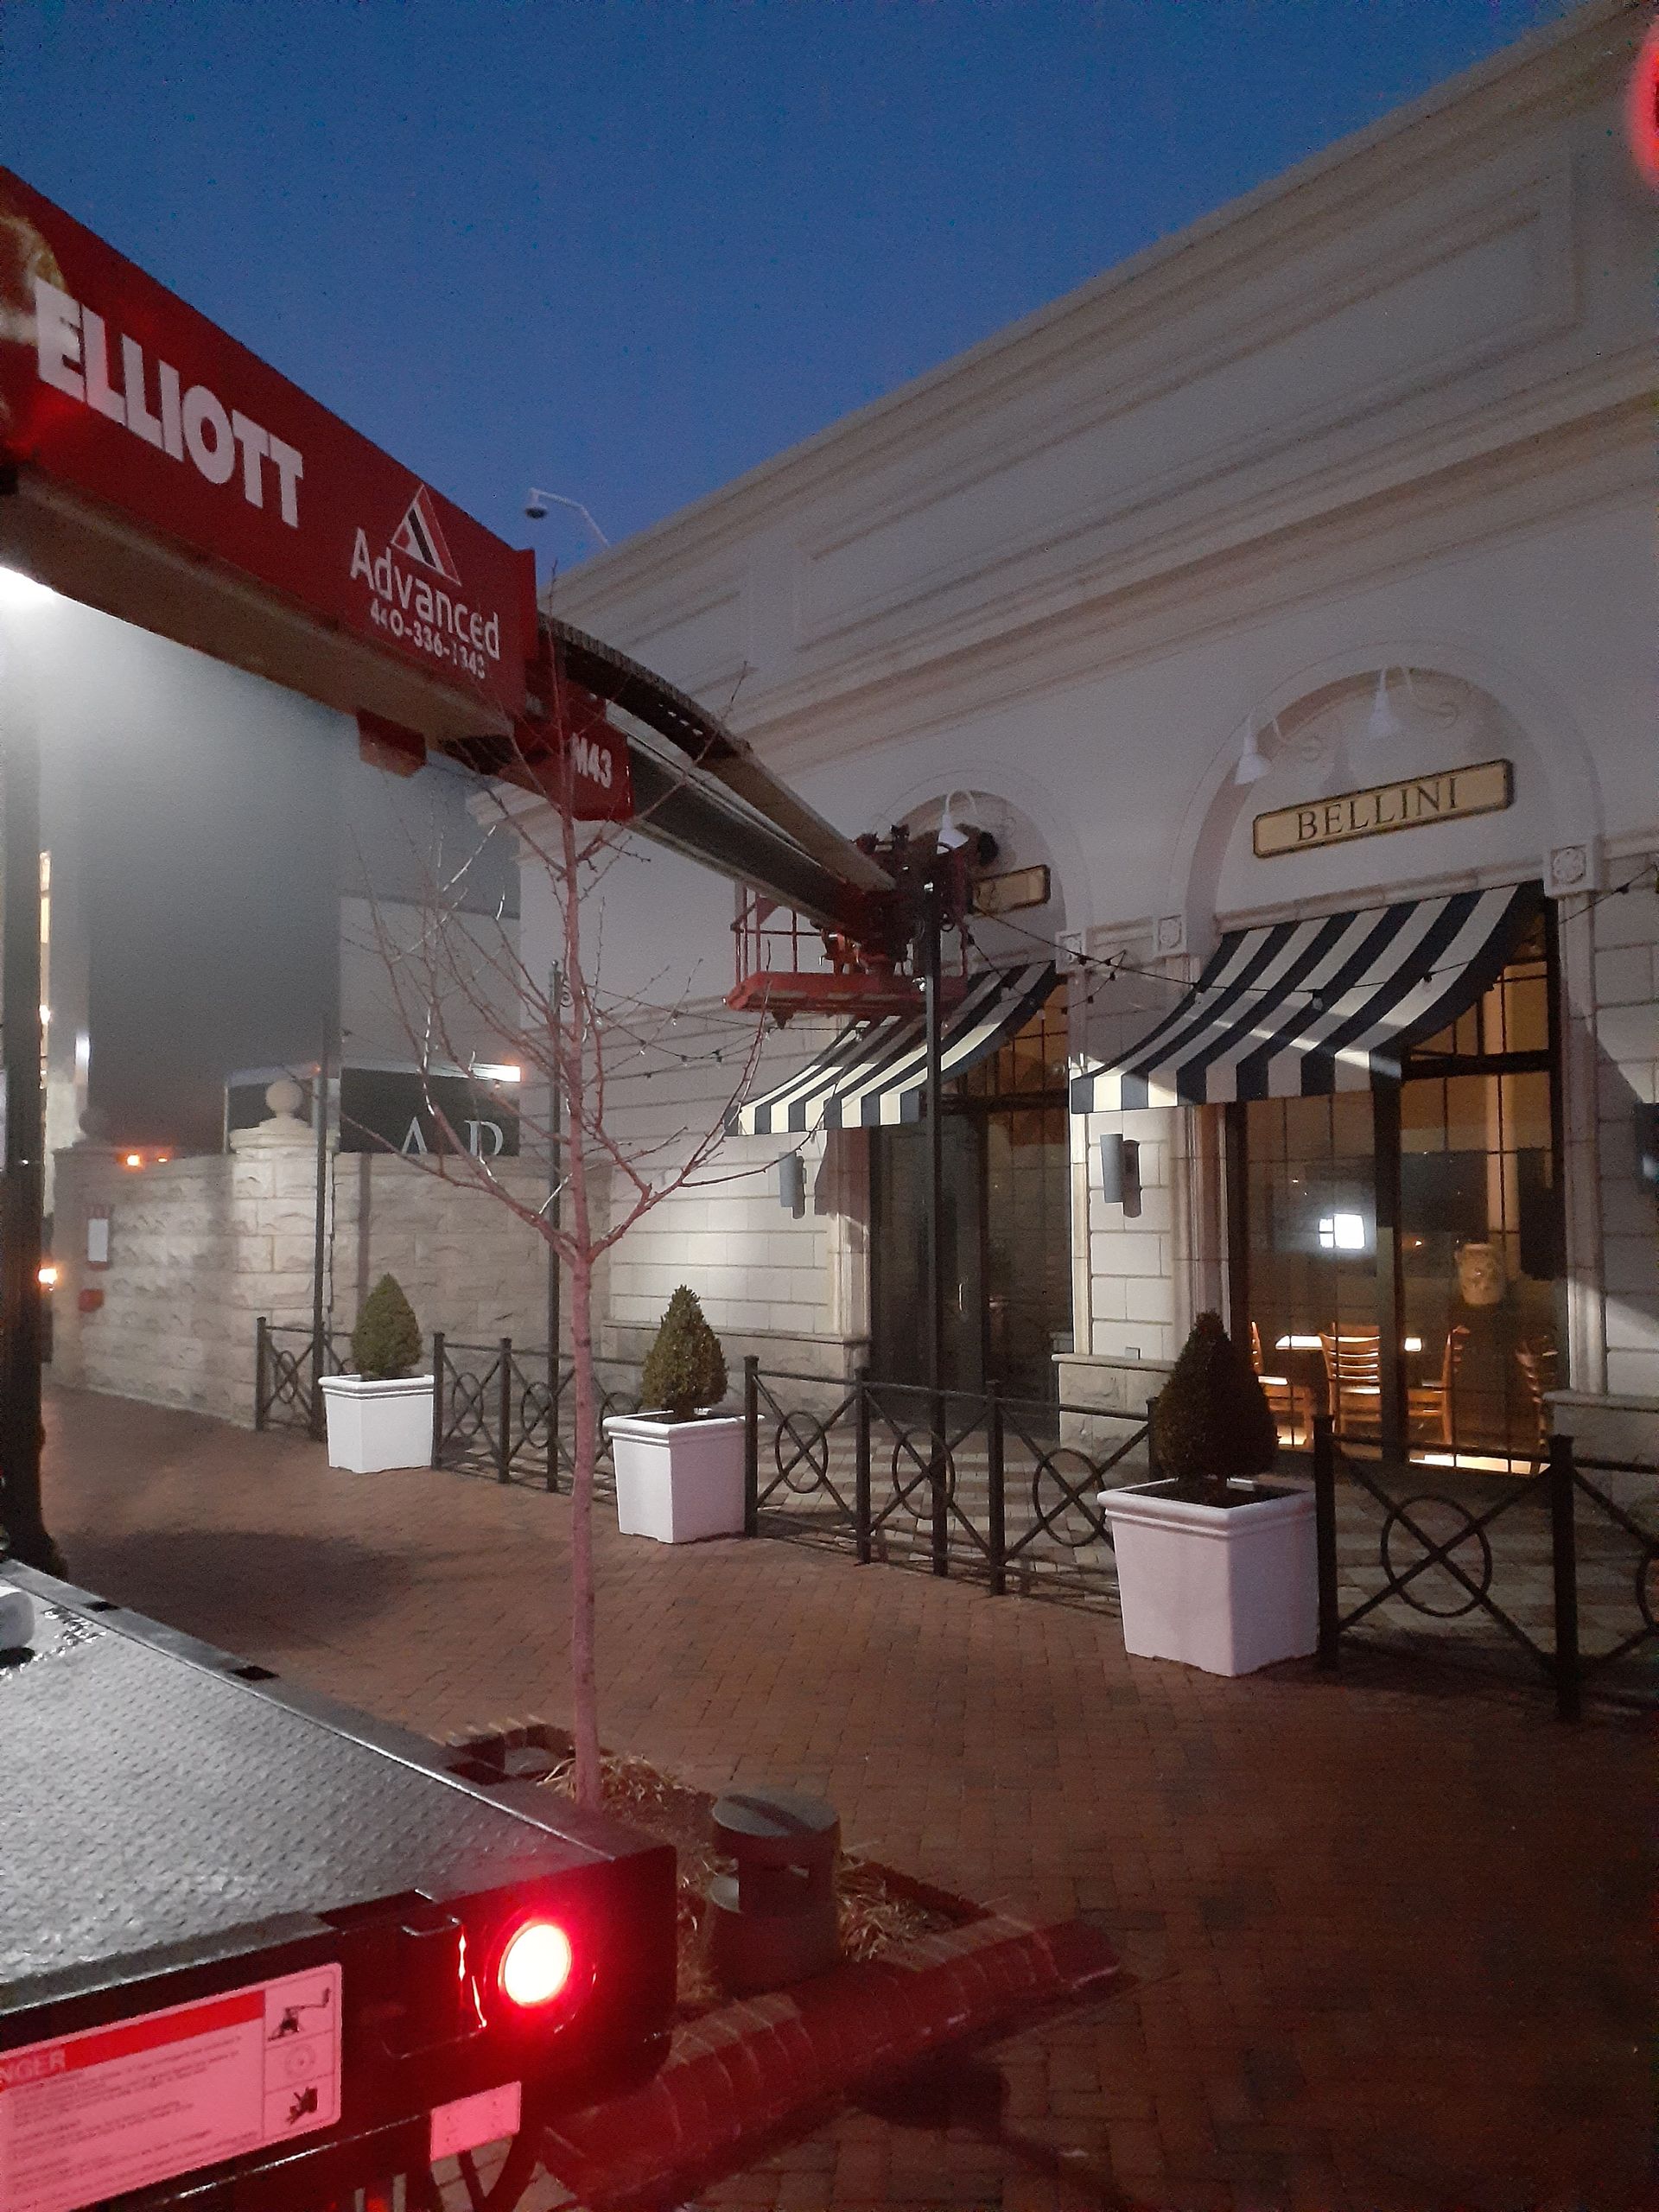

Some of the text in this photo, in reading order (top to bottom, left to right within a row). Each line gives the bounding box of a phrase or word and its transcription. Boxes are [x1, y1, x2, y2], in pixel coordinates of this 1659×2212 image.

[35, 276, 303, 529] ELLIOTT
[350, 528, 500, 661] Advanced
[1297, 777, 1458, 841] BELLINI
